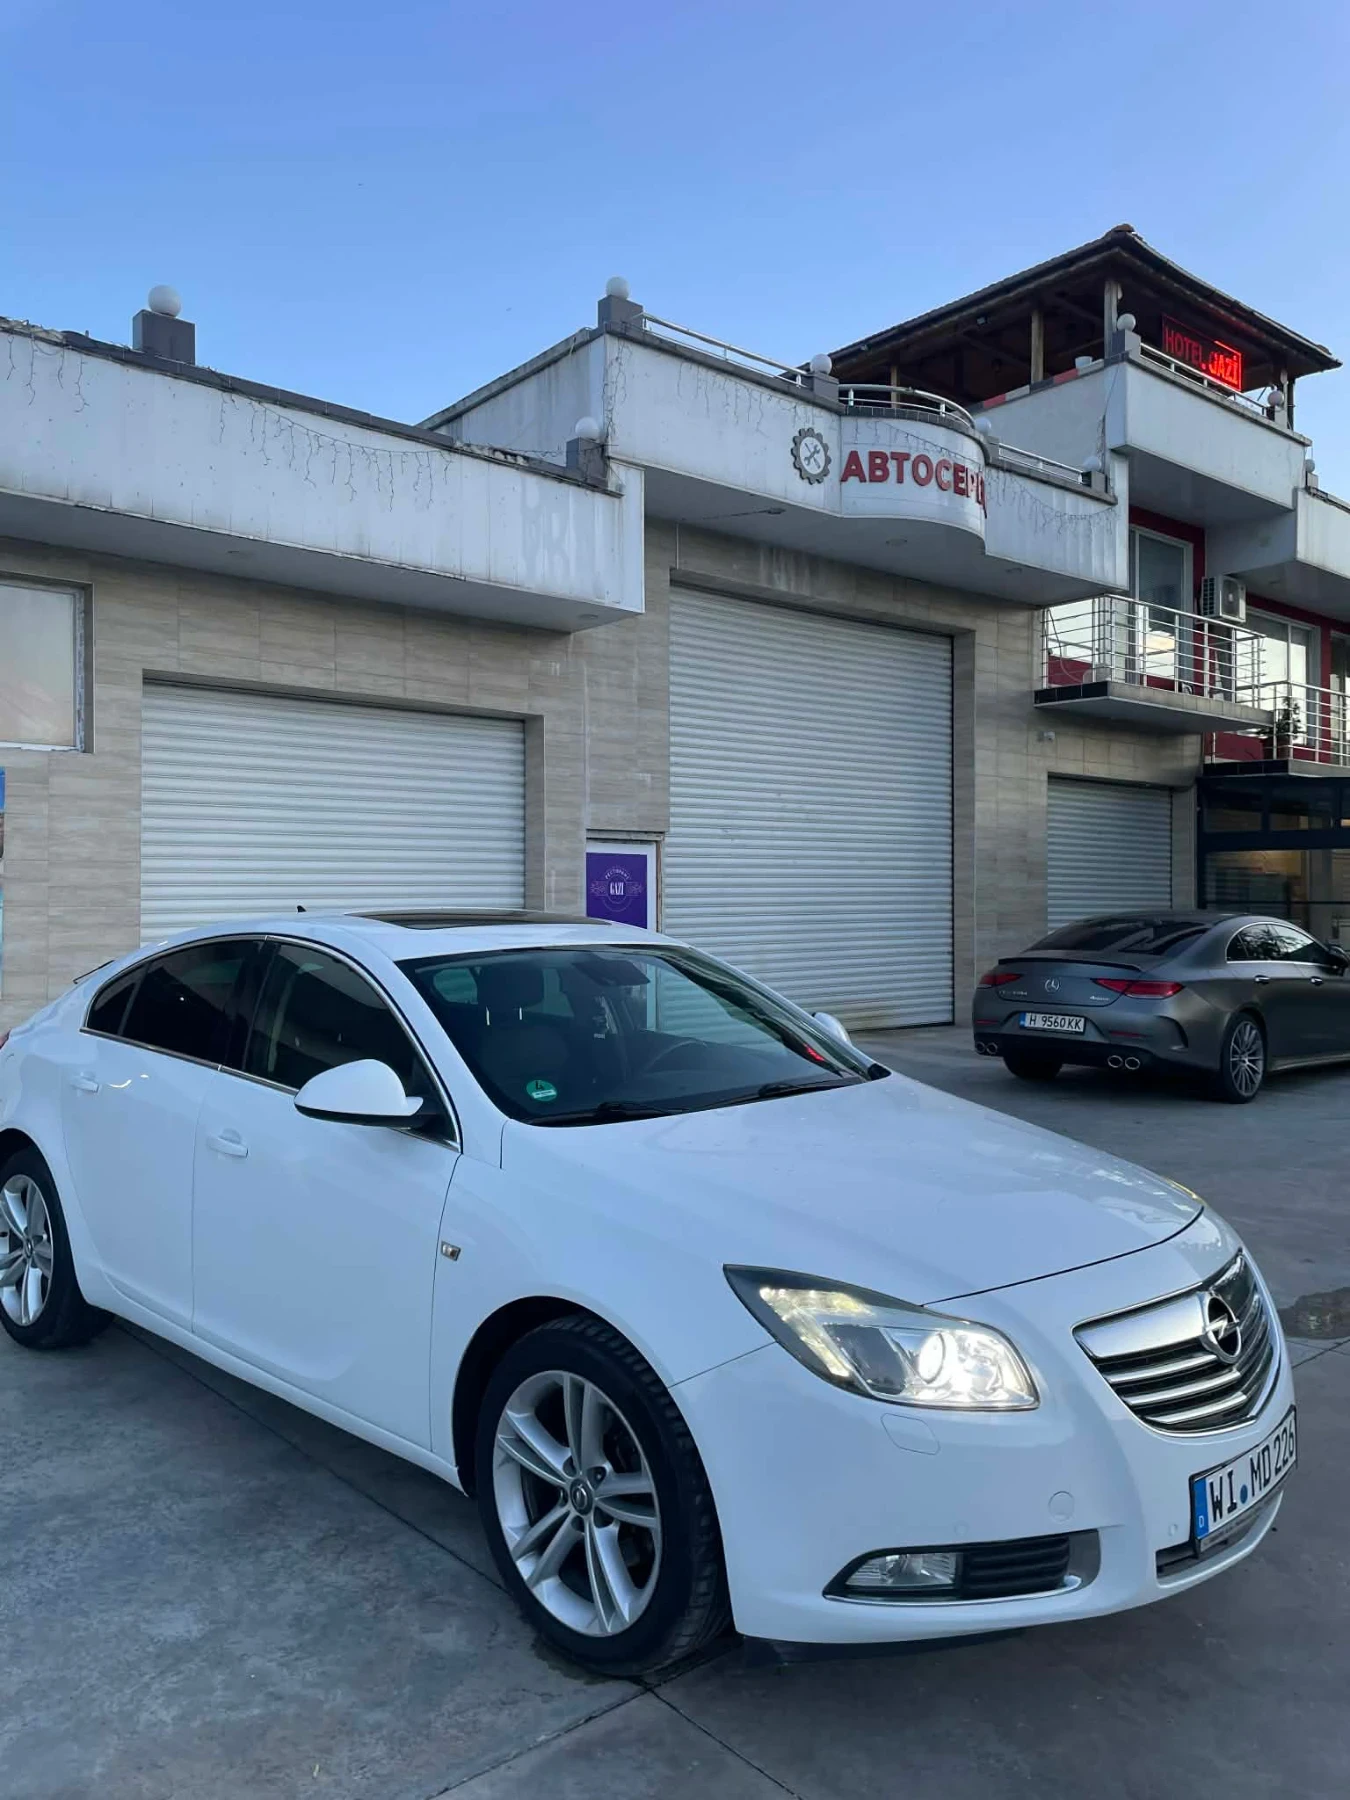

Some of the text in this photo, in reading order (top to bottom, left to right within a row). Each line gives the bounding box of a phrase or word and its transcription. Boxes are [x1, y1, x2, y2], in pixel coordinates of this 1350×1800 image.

[1165, 327, 1206, 370] HOTEL
[1209, 1469, 1237, 1523] WI
[1250, 1444, 1272, 1497] MD
[1273, 1420, 1294, 1476] 226
[1198, 1515, 1205, 1528] D
